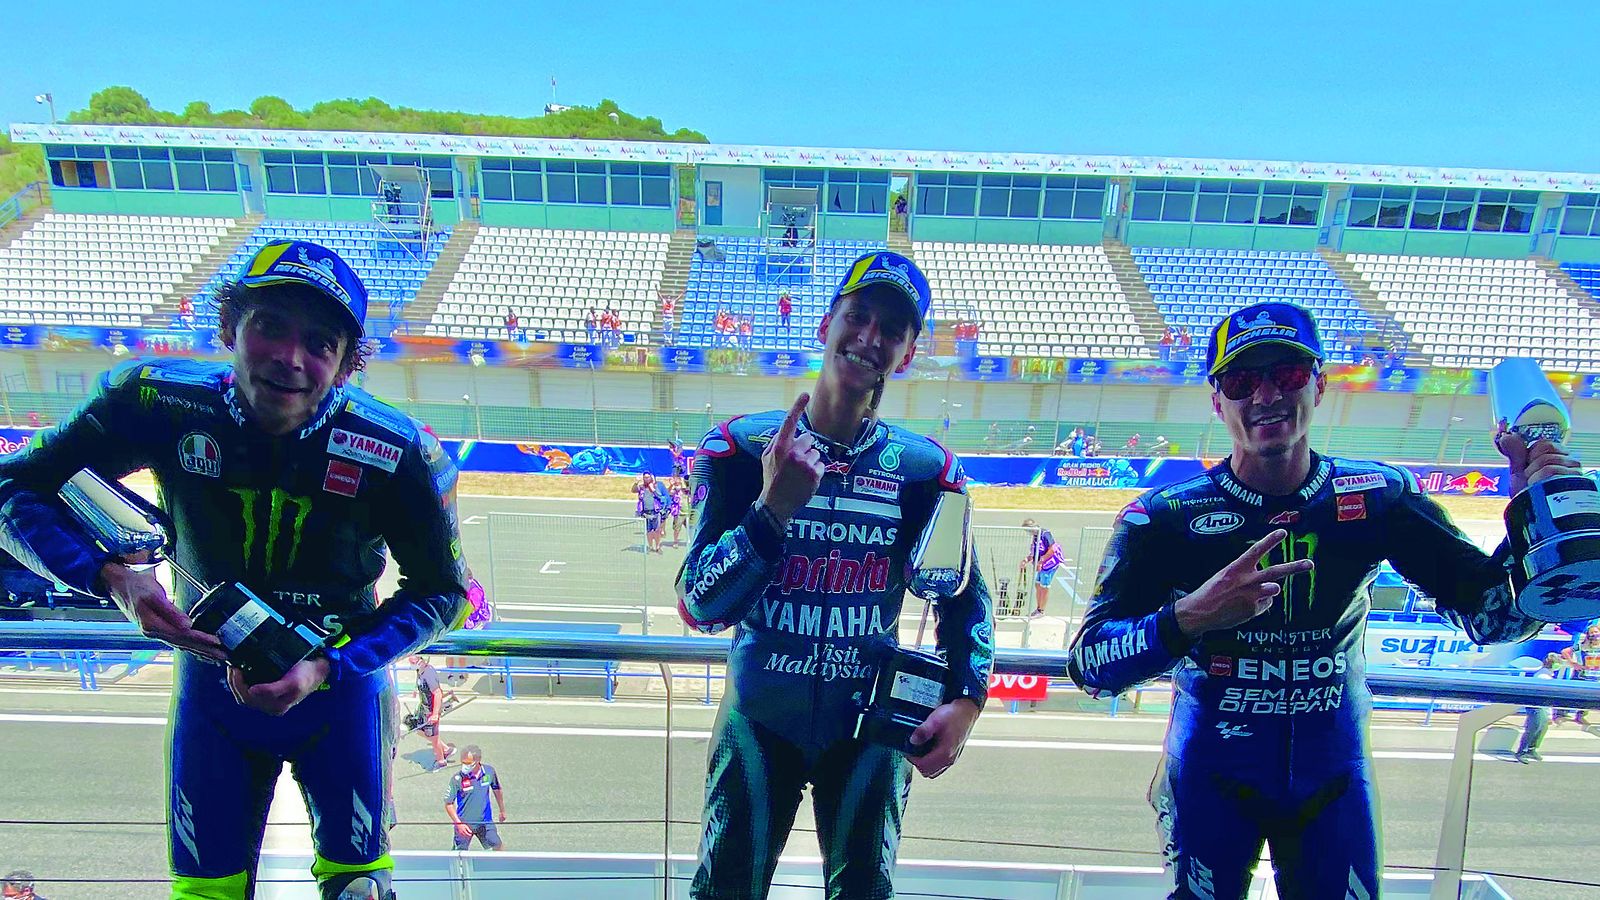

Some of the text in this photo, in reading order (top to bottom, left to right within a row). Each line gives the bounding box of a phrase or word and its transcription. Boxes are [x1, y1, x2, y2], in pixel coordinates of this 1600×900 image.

[274, 264, 352, 305] MICHELIN
[862, 271, 921, 302] MICHELIN
[1226, 328, 1297, 353] MICHELIN
[350, 434, 400, 462] YAMAHA
[866, 478, 897, 493] YAMAHA
[868, 468, 905, 482] PETRONAS
[1345, 474, 1385, 486] YAMAHA
[1220, 474, 1263, 507] YAMAHA
[1198, 513, 1237, 528] Arai
[763, 598, 885, 638] YAMAHA
[1236, 627, 1332, 645] MONSTER
[812, 642, 861, 664] Visit
[1074, 628, 1148, 675] YAMAHA
[1237, 651, 1347, 682] ENEOS
[1251, 697, 1342, 715] DEPAN
